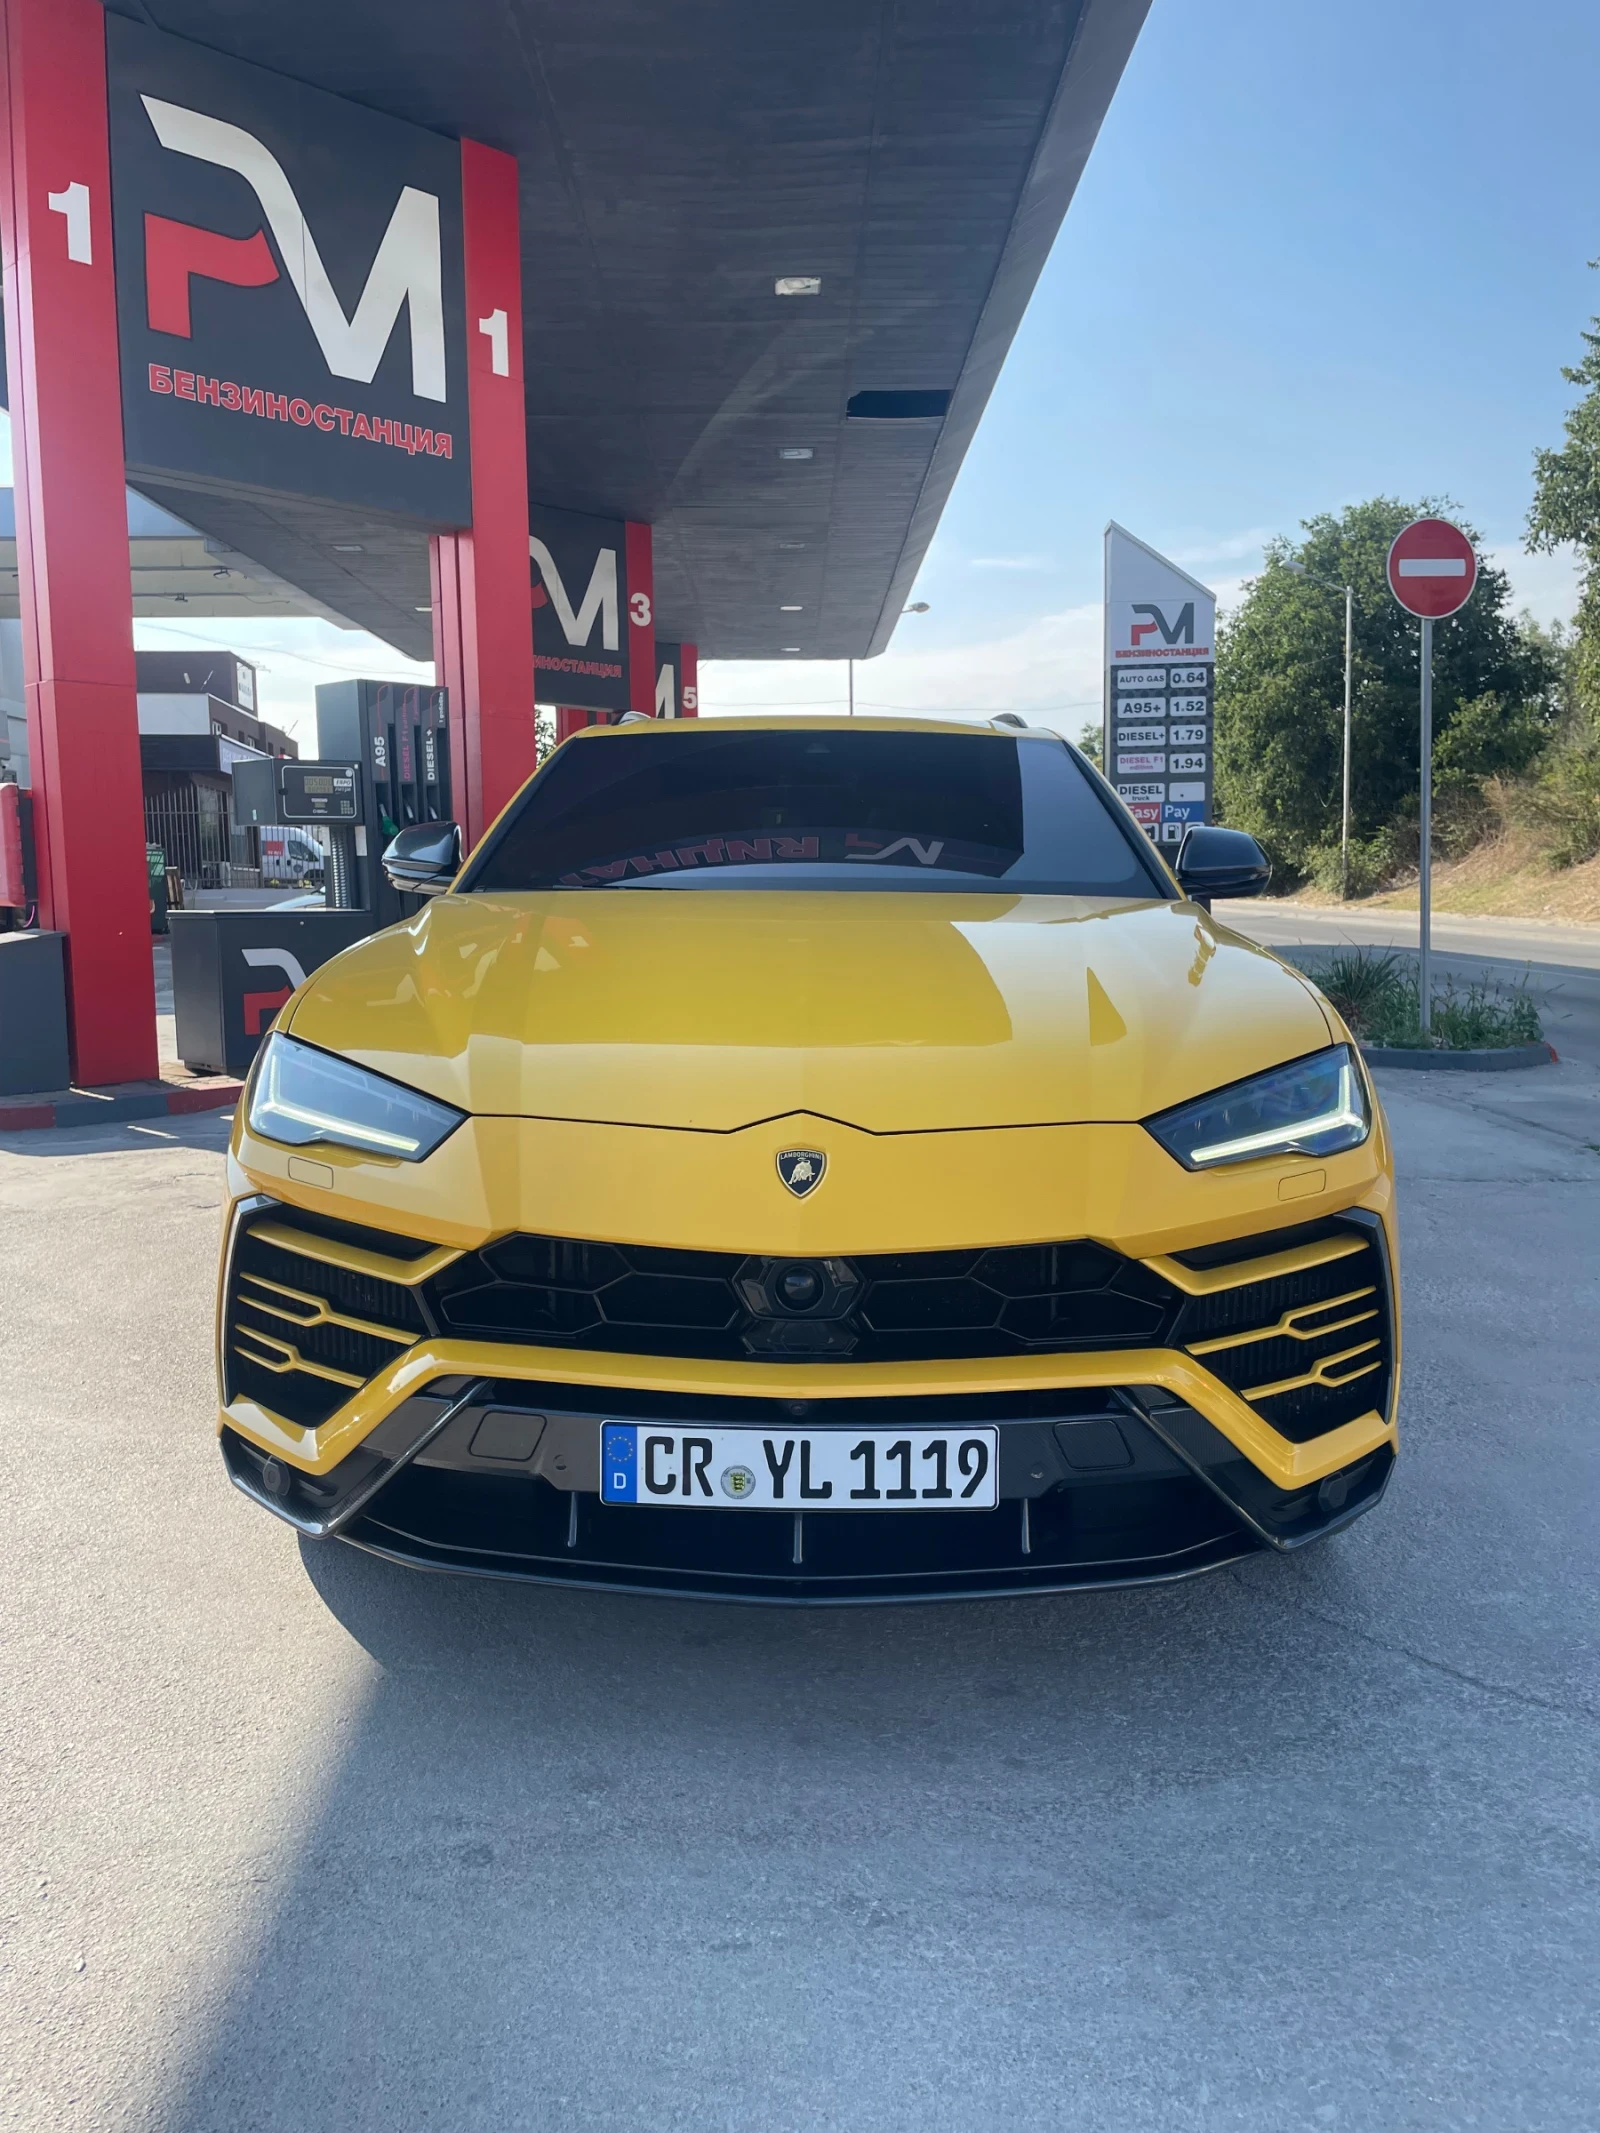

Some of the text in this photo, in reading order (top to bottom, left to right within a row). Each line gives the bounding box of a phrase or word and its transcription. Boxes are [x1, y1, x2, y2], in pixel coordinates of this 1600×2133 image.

[48, 181, 92, 266] 1
[479, 308, 509, 378] 1
[148, 362, 454, 459] БЕНЗИНОСТАНЦИЯ
[630, 592, 652, 627] 3
[533, 654, 622, 678] ИНОСТАНЦИЯ
[1172, 672, 1205, 684] 0.64
[682, 687, 697, 710] 5
[1123, 701, 1205, 714] A95+ 1.52
[1118, 729, 1204, 741] DIESEL+ 1.79
[374, 736, 386, 767] A95
[402, 745, 410, 779] DIESEL
[1173, 758, 1203, 769] 1.94
[1120, 785, 1162, 795] DIESEL
[1165, 805, 1190, 820] Pay
[780, 1152, 821, 1160] LAMBORGHINI
[644, 1435, 714, 1497] CR
[762, 1439, 833, 1499] YL
[850, 1439, 989, 1499] 1119
[613, 1472, 626, 1489] D
